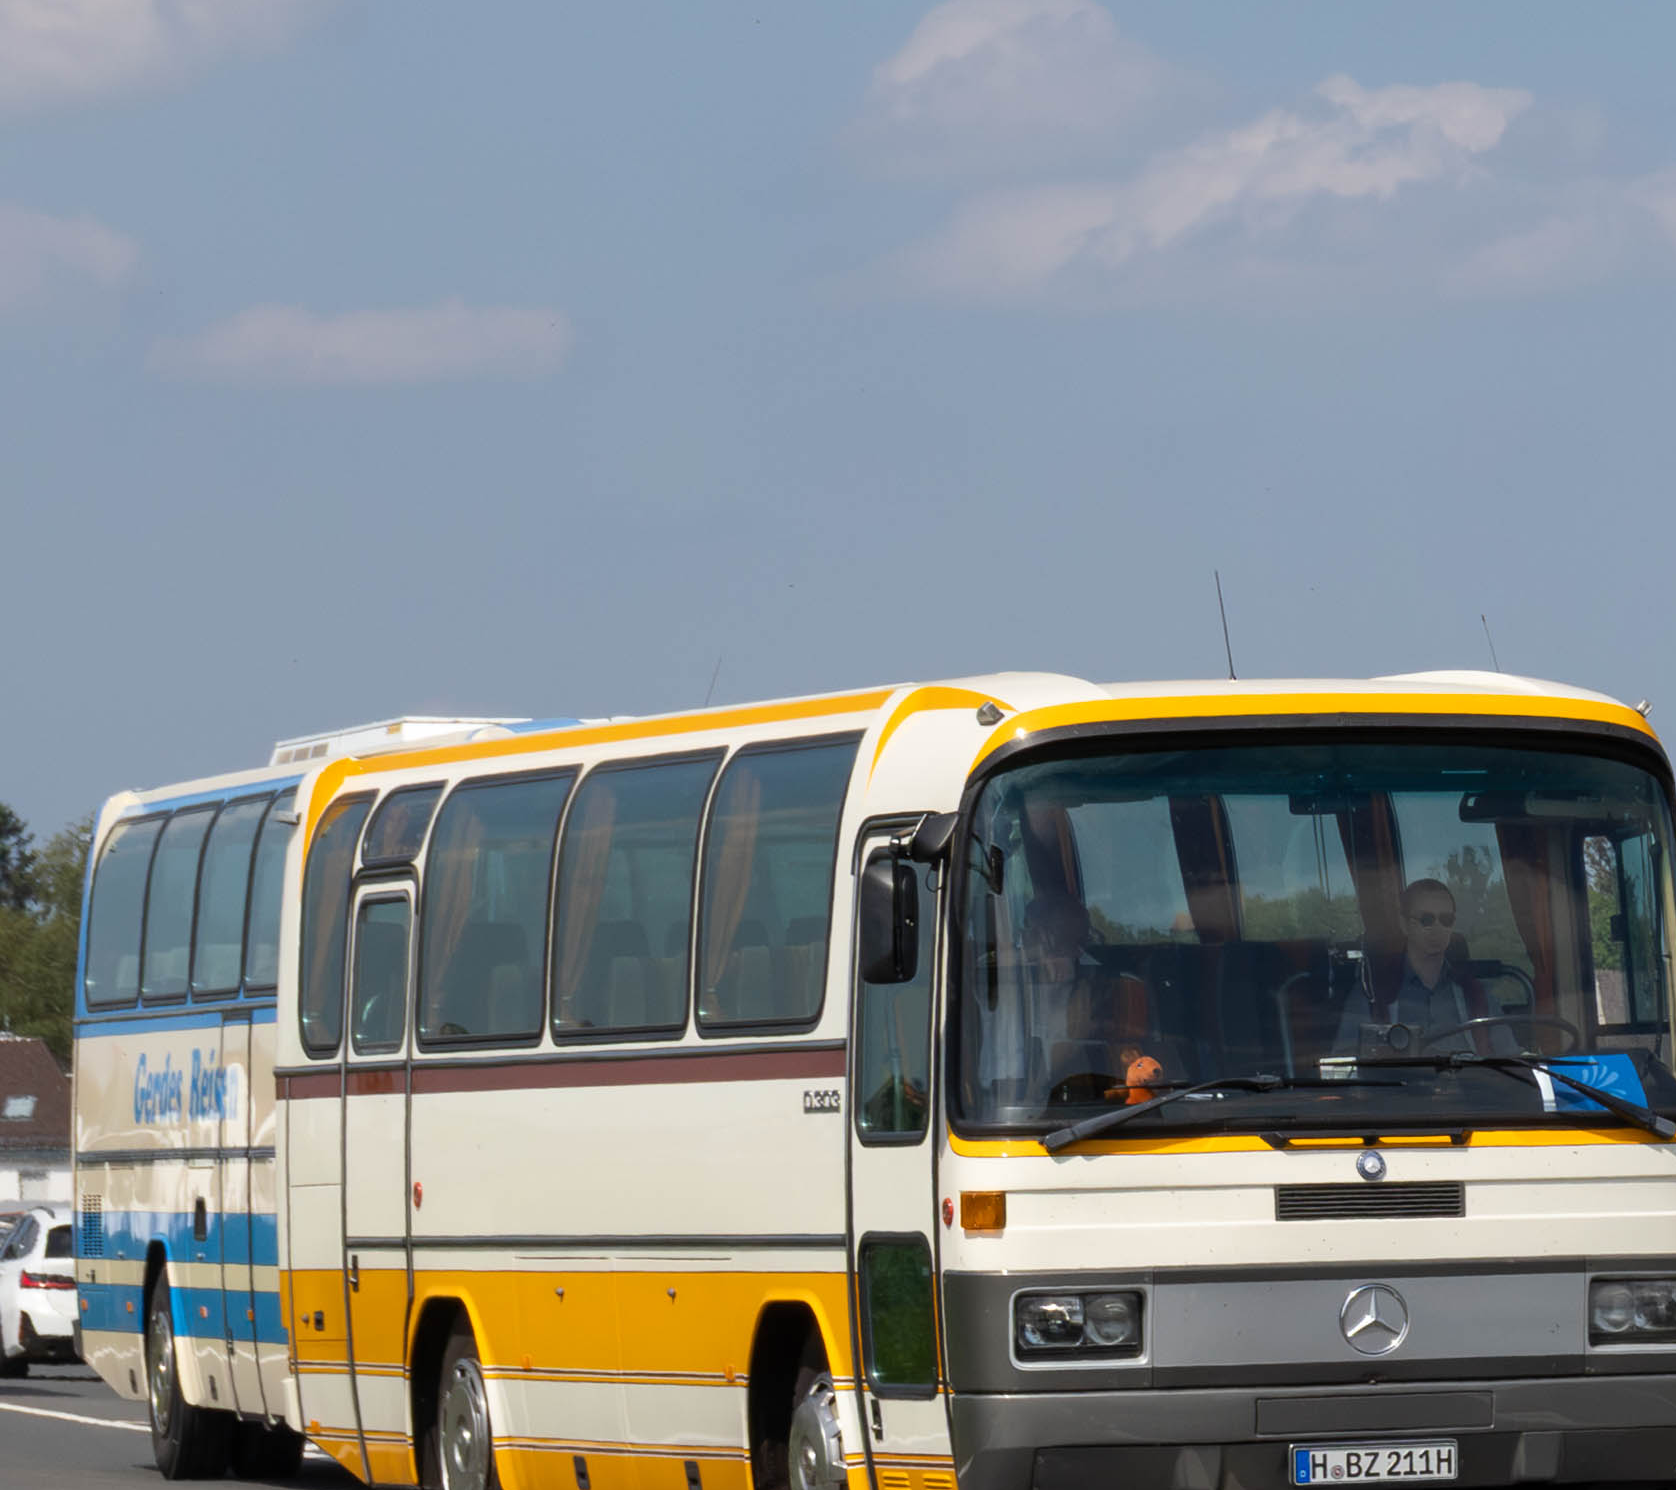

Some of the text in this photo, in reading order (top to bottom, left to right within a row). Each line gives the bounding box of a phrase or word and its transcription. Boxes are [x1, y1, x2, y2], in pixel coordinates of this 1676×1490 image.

[189, 1047, 238, 1122] Reisen
[1311, 1453, 1328, 1479] H
[1346, 1452, 1380, 1478] BZ
[1387, 1448, 1453, 1476] 211H
